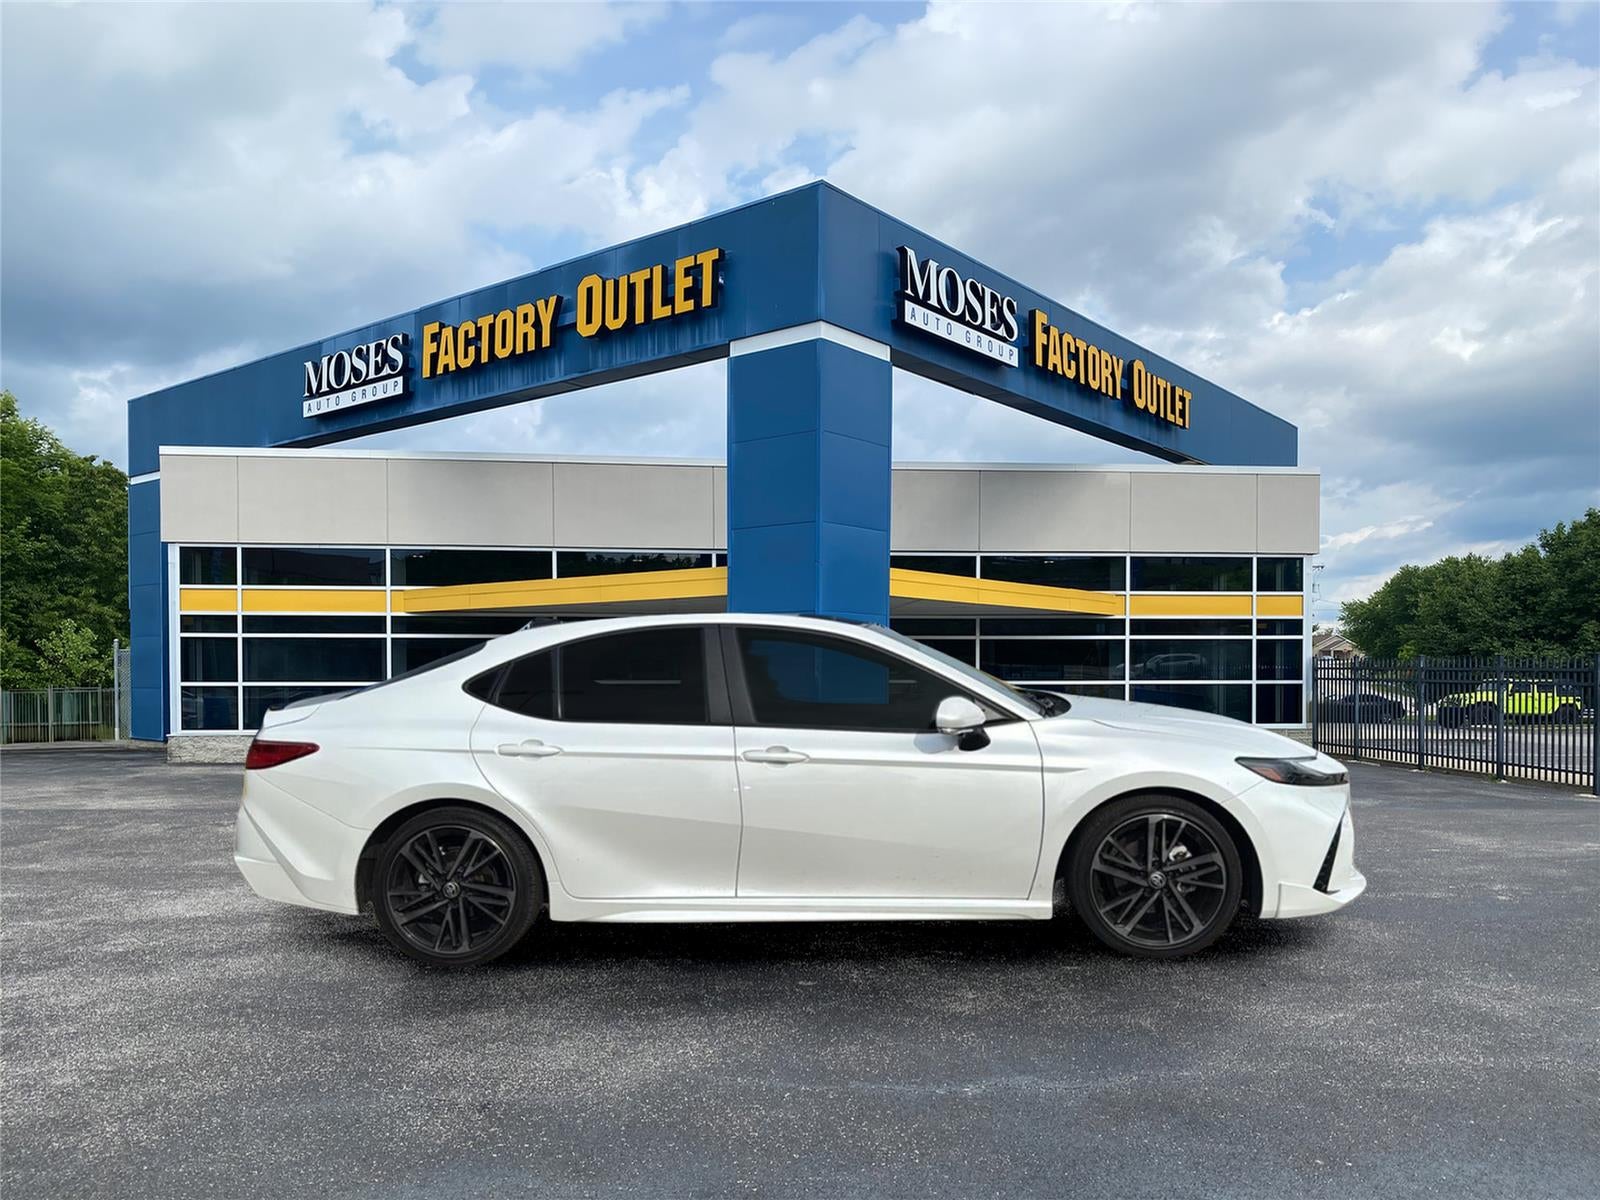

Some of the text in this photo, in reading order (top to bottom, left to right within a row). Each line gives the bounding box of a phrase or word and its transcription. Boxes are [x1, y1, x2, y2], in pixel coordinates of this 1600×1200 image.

[422, 247, 720, 379] FACTORY OUTLET
[904, 246, 1019, 343] MOSES
[910, 306, 1015, 361] AUTO GROUP
[303, 333, 404, 397] MOSES
[307, 380, 399, 413] AUTO GROUP
[1034, 308, 1192, 429] FACTORY OUTLET
